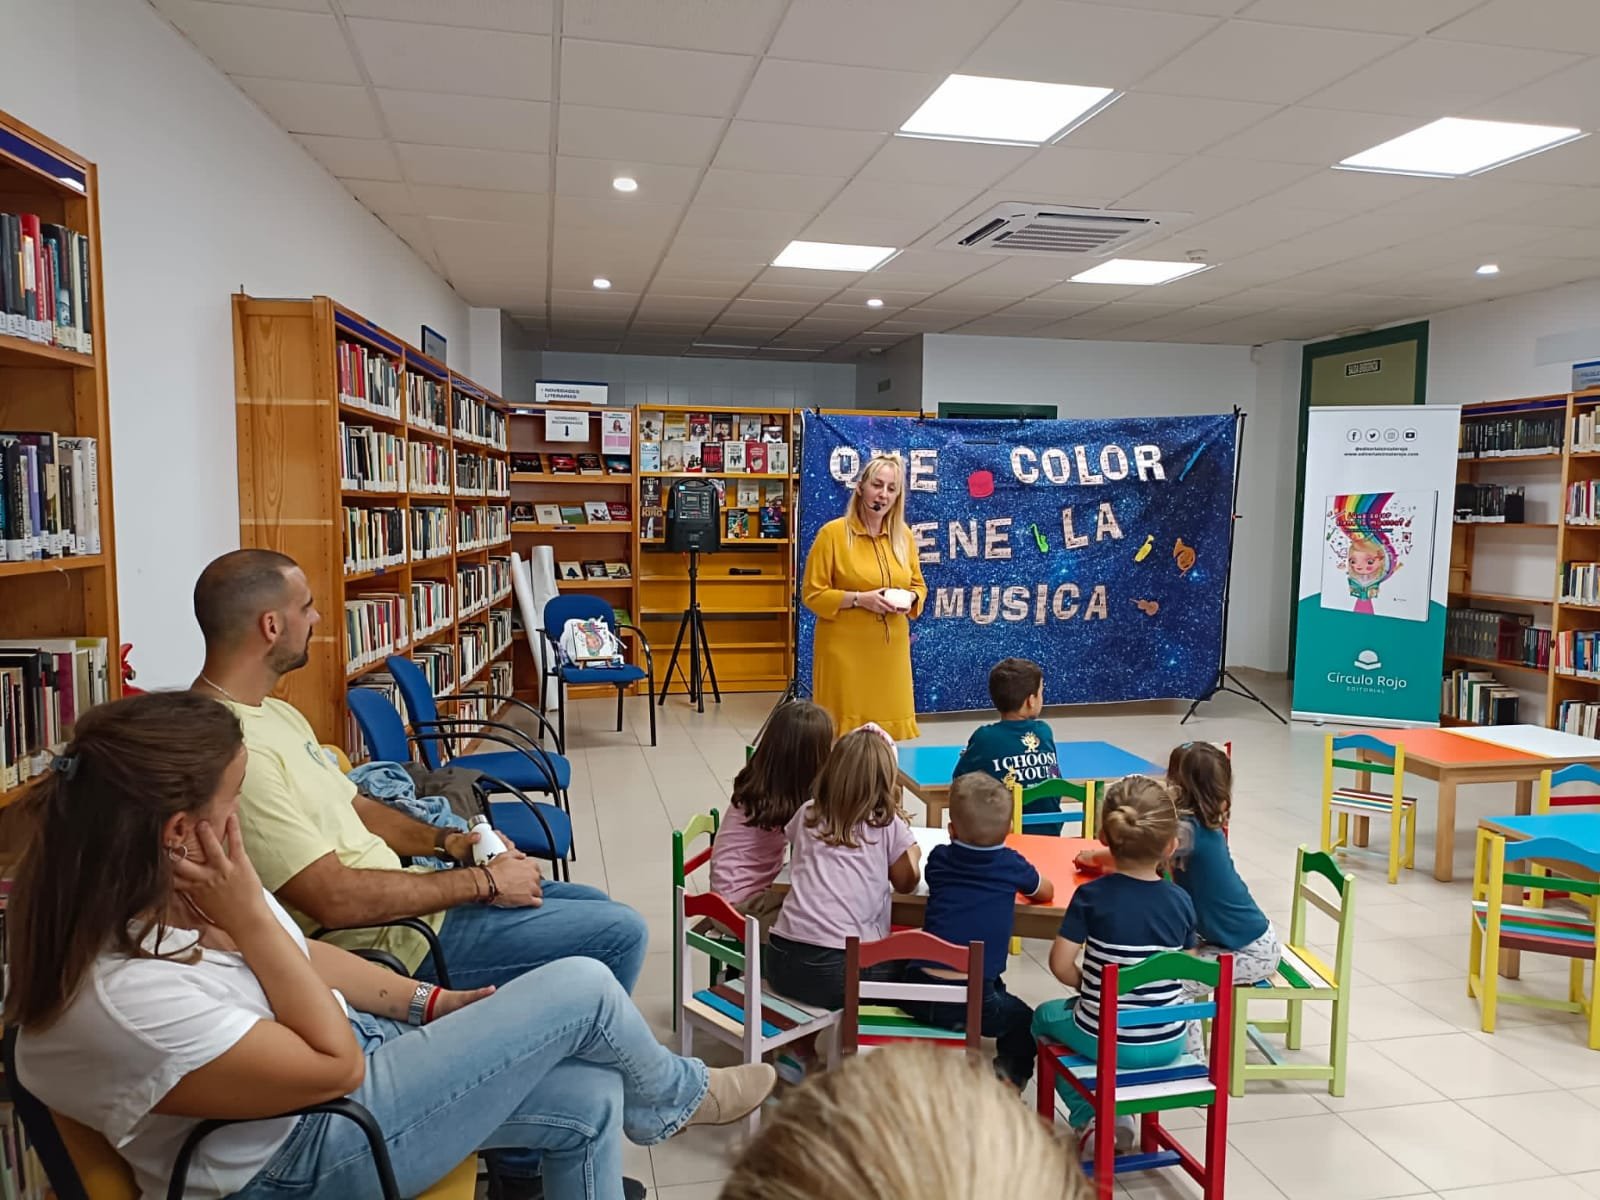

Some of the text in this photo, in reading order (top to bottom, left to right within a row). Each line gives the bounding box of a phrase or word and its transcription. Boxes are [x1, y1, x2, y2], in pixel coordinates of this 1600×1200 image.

[829, 444, 1166, 492] QE COLOR
[1062, 502, 1124, 550] LA
[934, 582, 1108, 625] MUSICA
[1327, 671, 1407, 690] Círculo Rojo
[992, 758, 1001, 772] I
